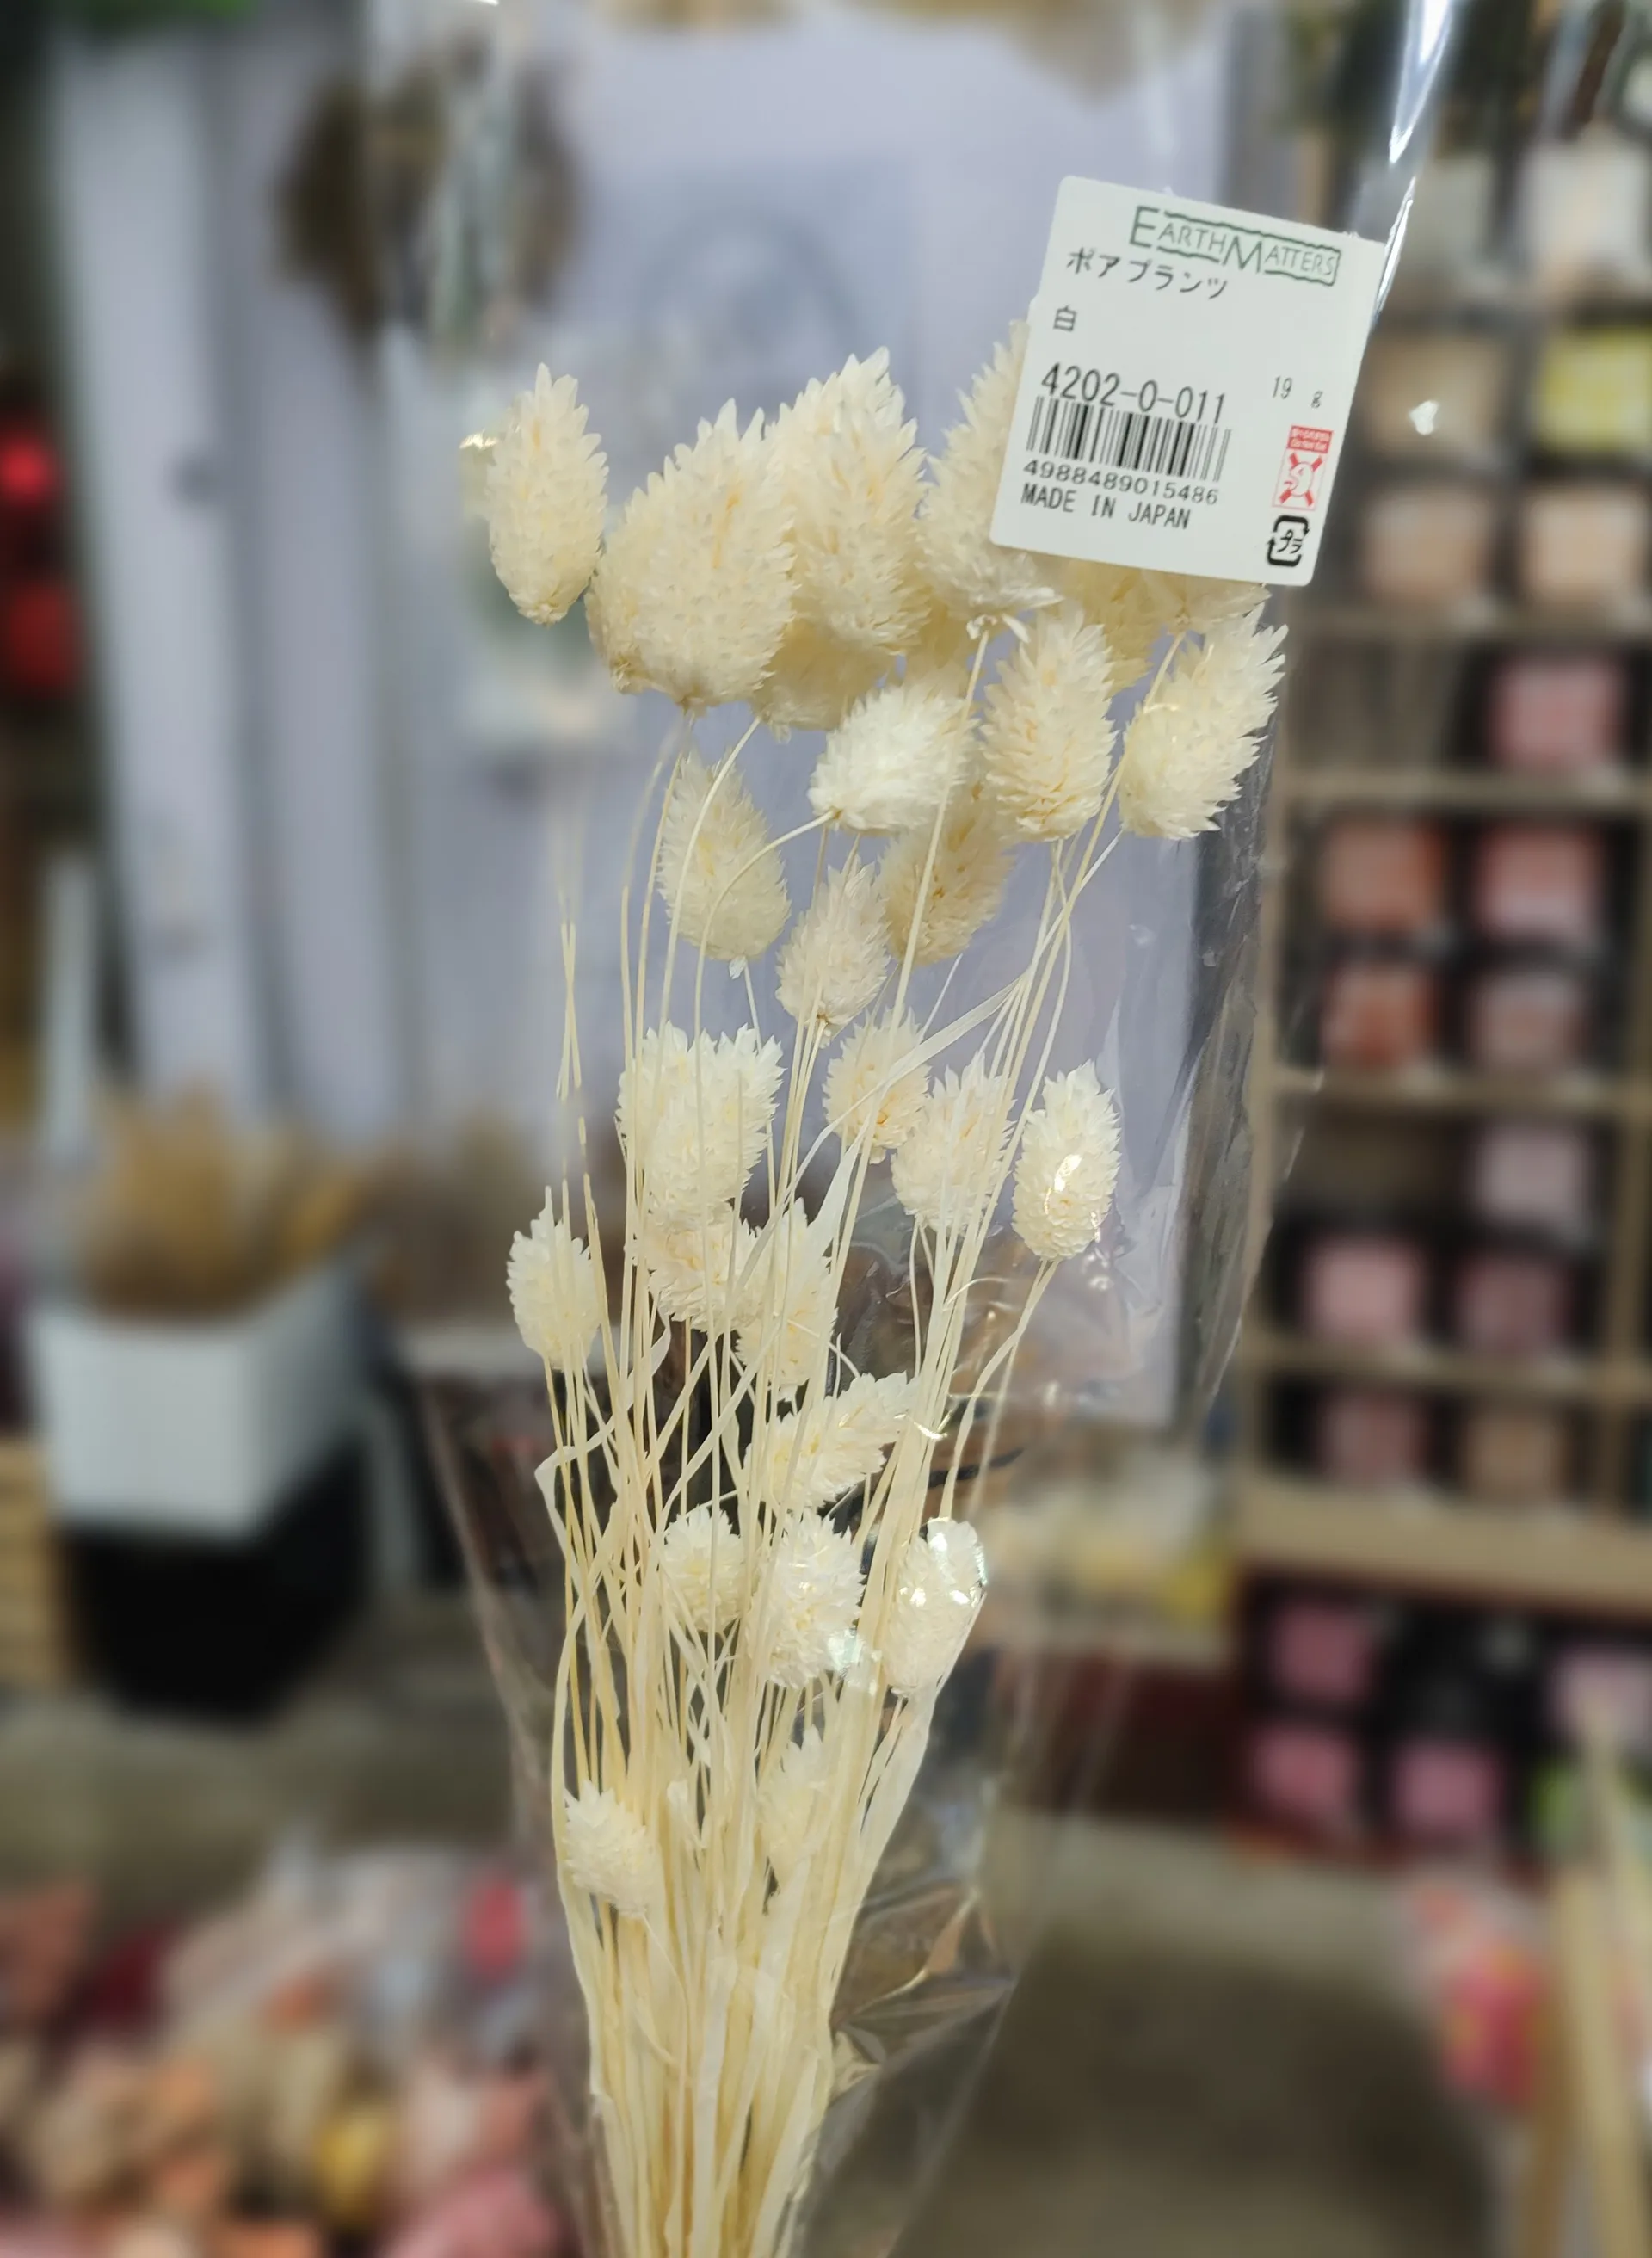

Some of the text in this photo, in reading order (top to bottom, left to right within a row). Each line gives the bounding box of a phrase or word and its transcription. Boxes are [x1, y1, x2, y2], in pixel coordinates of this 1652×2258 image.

[1053, 305, 1077, 332] 白
[1041, 362, 1226, 424] 4202-0-011
[1273, 375, 1293, 400] 19
[1023, 460, 1220, 506] 4988489015486
[1020, 482, 1192, 530] MADE IN JAPAN
[1277, 529, 1304, 554] プラ
